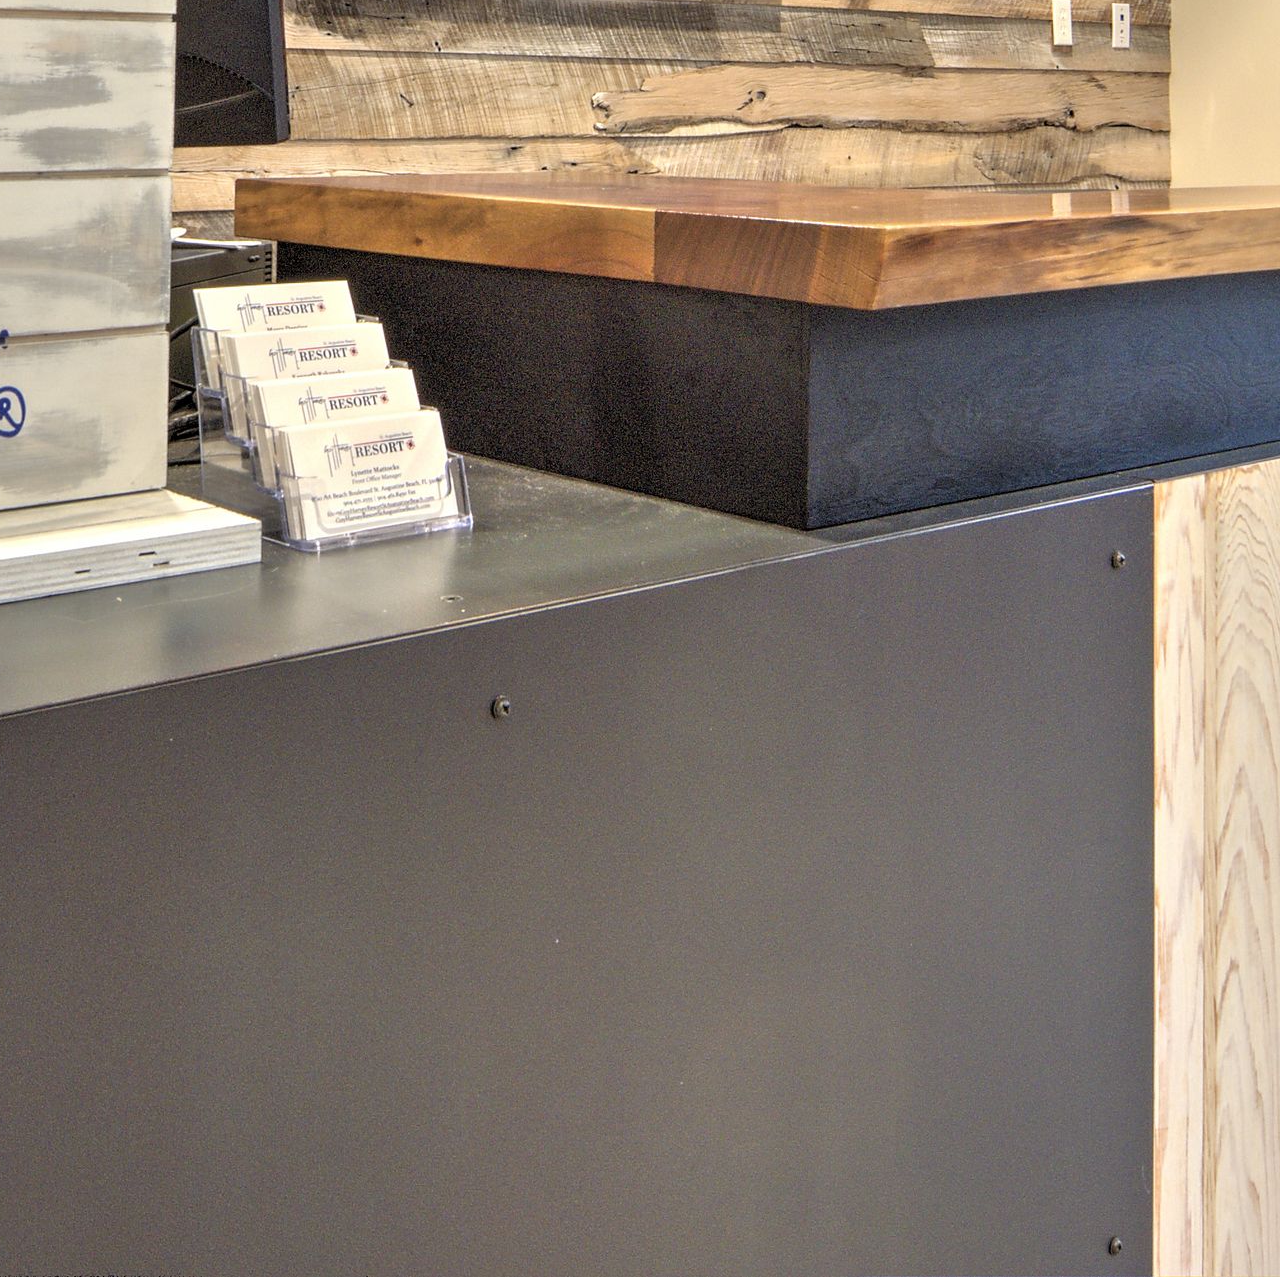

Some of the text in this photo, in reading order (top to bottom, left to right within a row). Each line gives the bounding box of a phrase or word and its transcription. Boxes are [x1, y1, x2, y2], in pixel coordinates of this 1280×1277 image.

[267, 303, 315, 317] RESORT
[300, 347, 348, 362] RESORT
[329, 395, 378, 411] RESORT
[355, 440, 404, 458] RESORT
